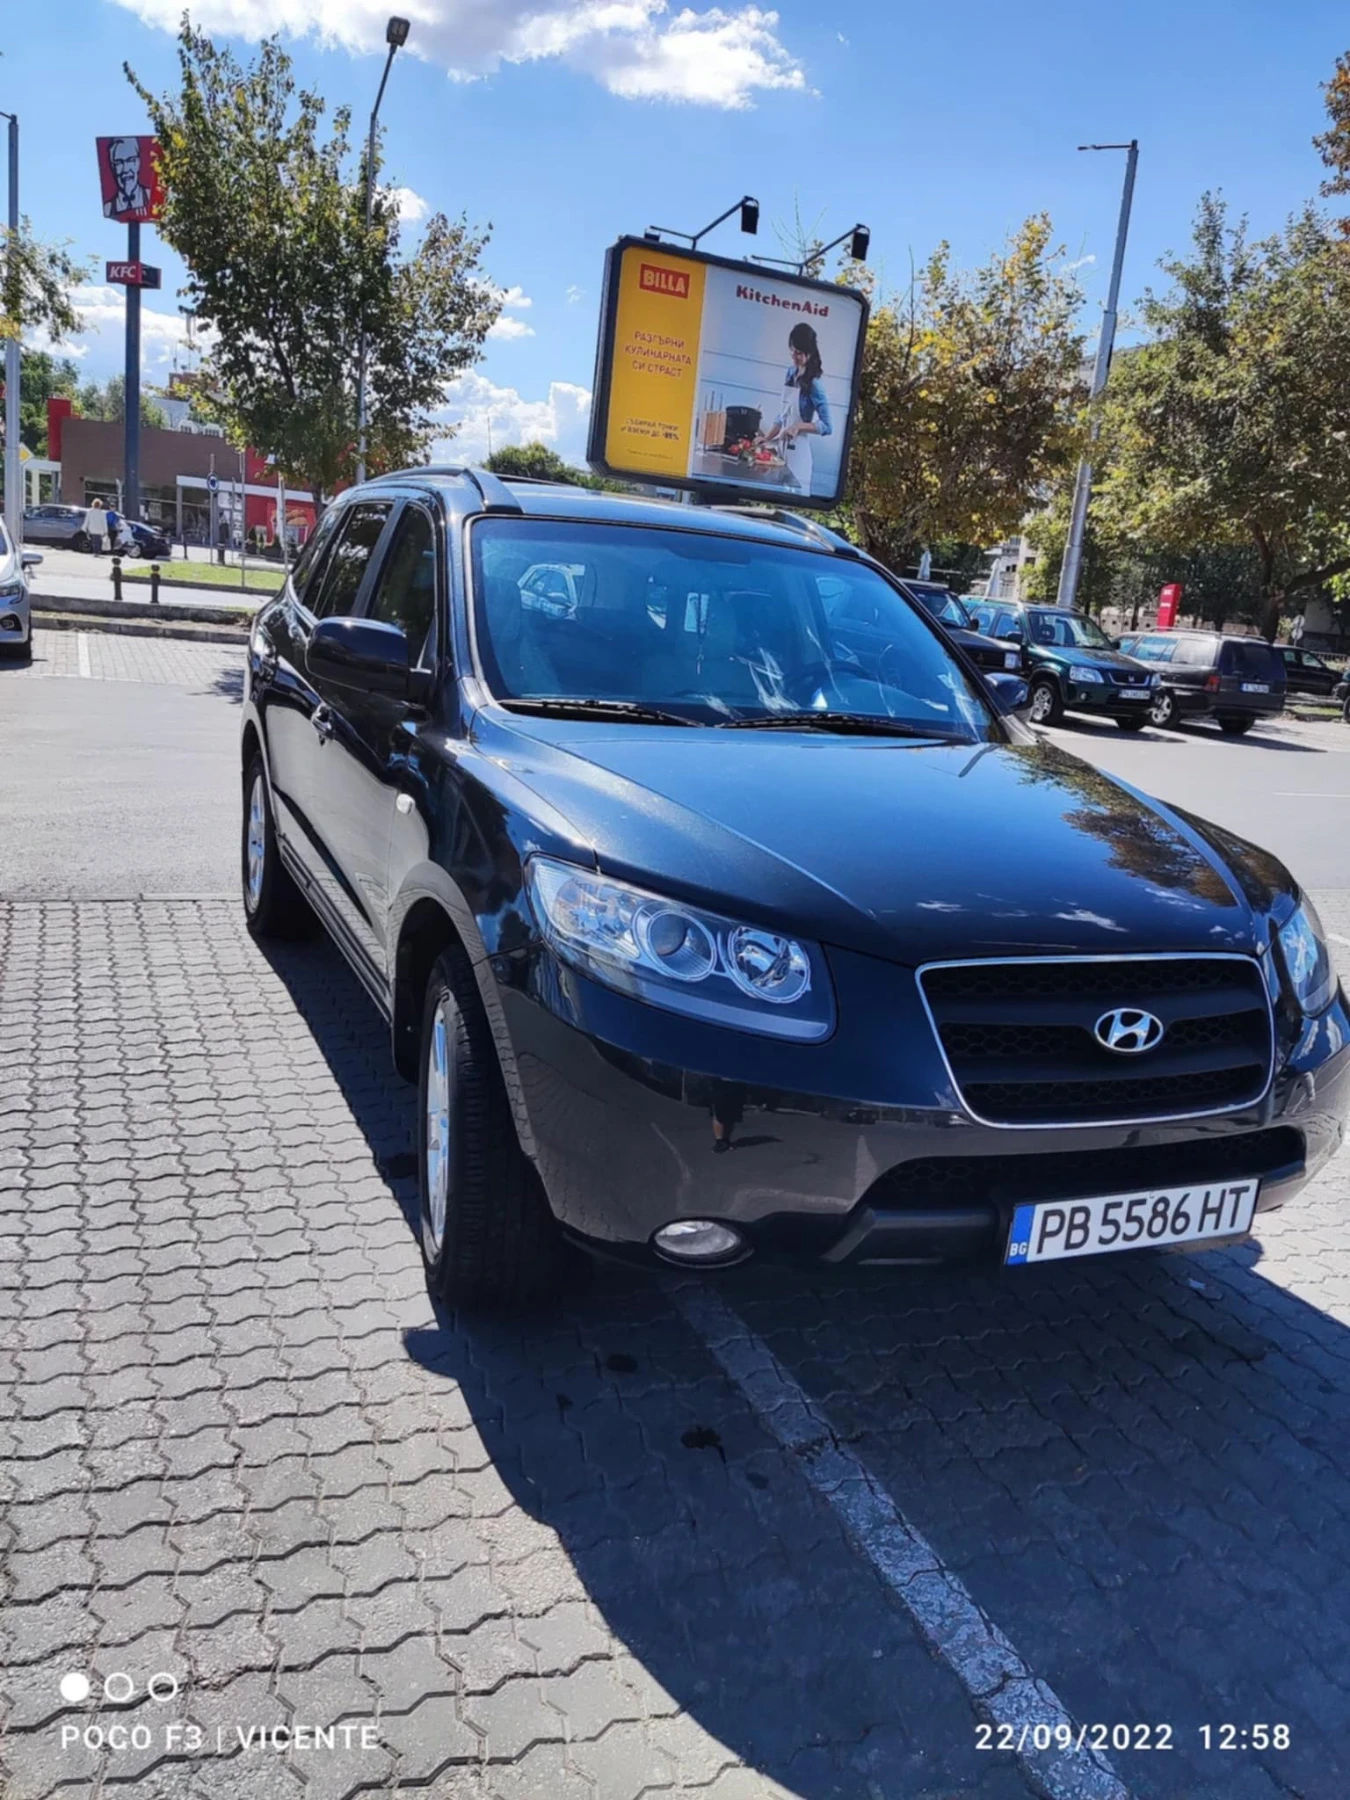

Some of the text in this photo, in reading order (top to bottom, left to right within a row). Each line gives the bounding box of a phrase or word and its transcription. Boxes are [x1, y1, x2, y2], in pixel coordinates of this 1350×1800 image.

[109, 265, 136, 278] KFC
[643, 269, 686, 295] BILLA
[736, 285, 829, 318] KitchenAid
[634, 331, 684, 349] РАЗГЪРНИ
[625, 345, 692, 365] КУЛИНАРНАТА
[632, 360, 682, 378] СИ СТРАСТ
[1098, 1193, 1191, 1246] 5586
[1009, 1242, 1027, 1257] BG
